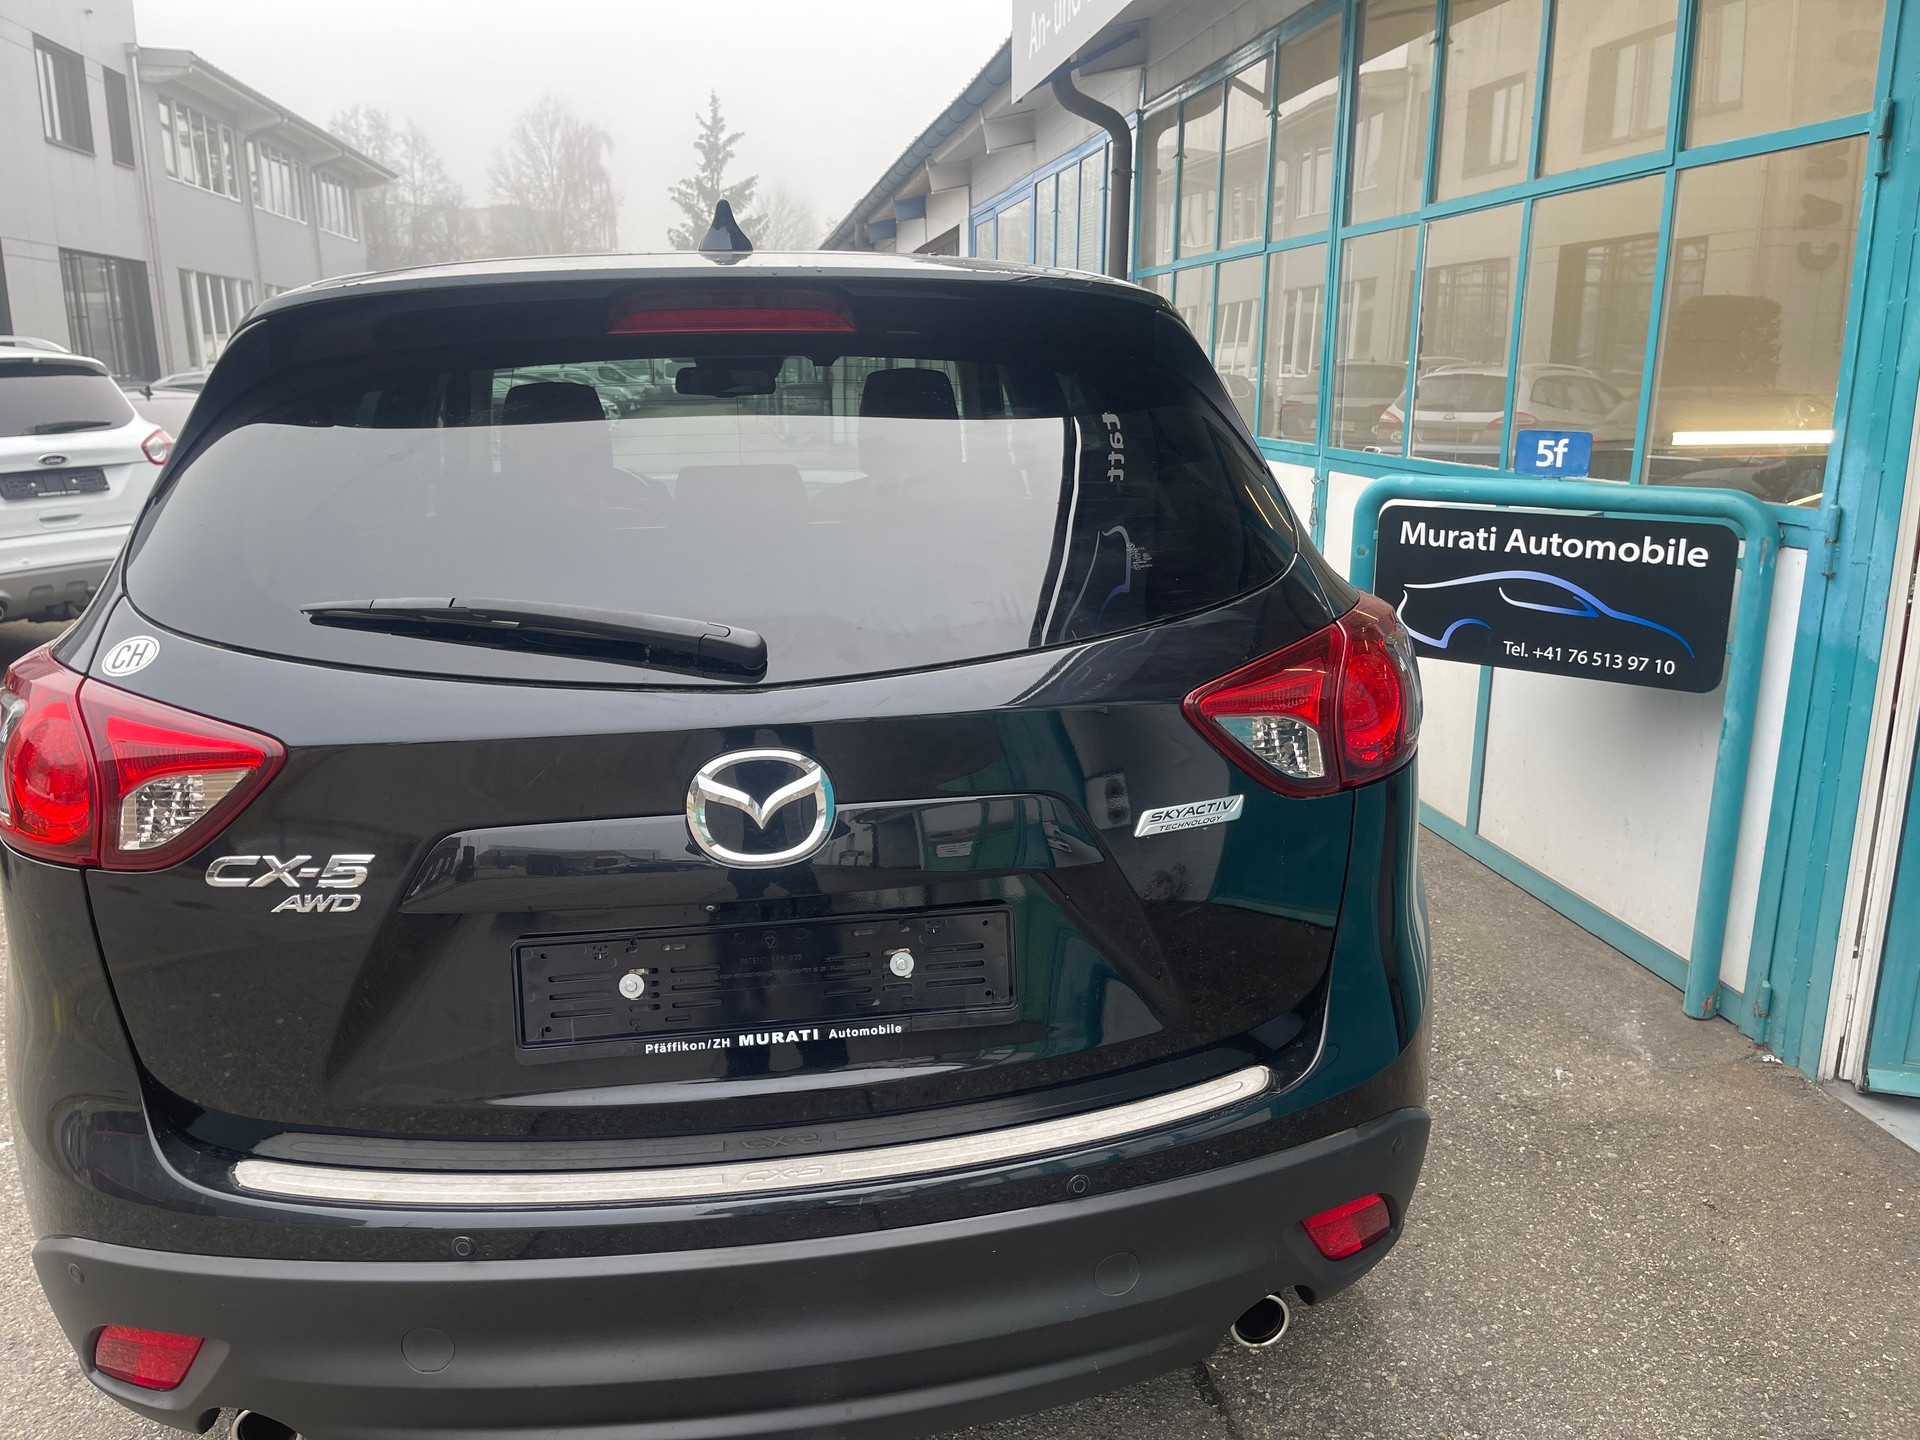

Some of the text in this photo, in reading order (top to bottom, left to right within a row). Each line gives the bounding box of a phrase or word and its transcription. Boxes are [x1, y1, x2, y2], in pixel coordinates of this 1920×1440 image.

[1028, 11, 1051, 59] An-
[1535, 438, 1569, 468] 5f
[1399, 521, 1709, 568] Murati Automobile
[111, 642, 147, 669] CH
[1503, 640, 1676, 675] Tel. +41 76 513 97 10
[1149, 799, 1235, 823] SKYACTIV
[1159, 814, 1223, 832] TECHNOLOGY
[204, 854, 376, 888] CX-5
[270, 893, 362, 913] AWD
[645, 1023, 902, 1054] Pfäffikon/ZH MURATI Automobile
[742, 1163, 825, 1183] CX-5
